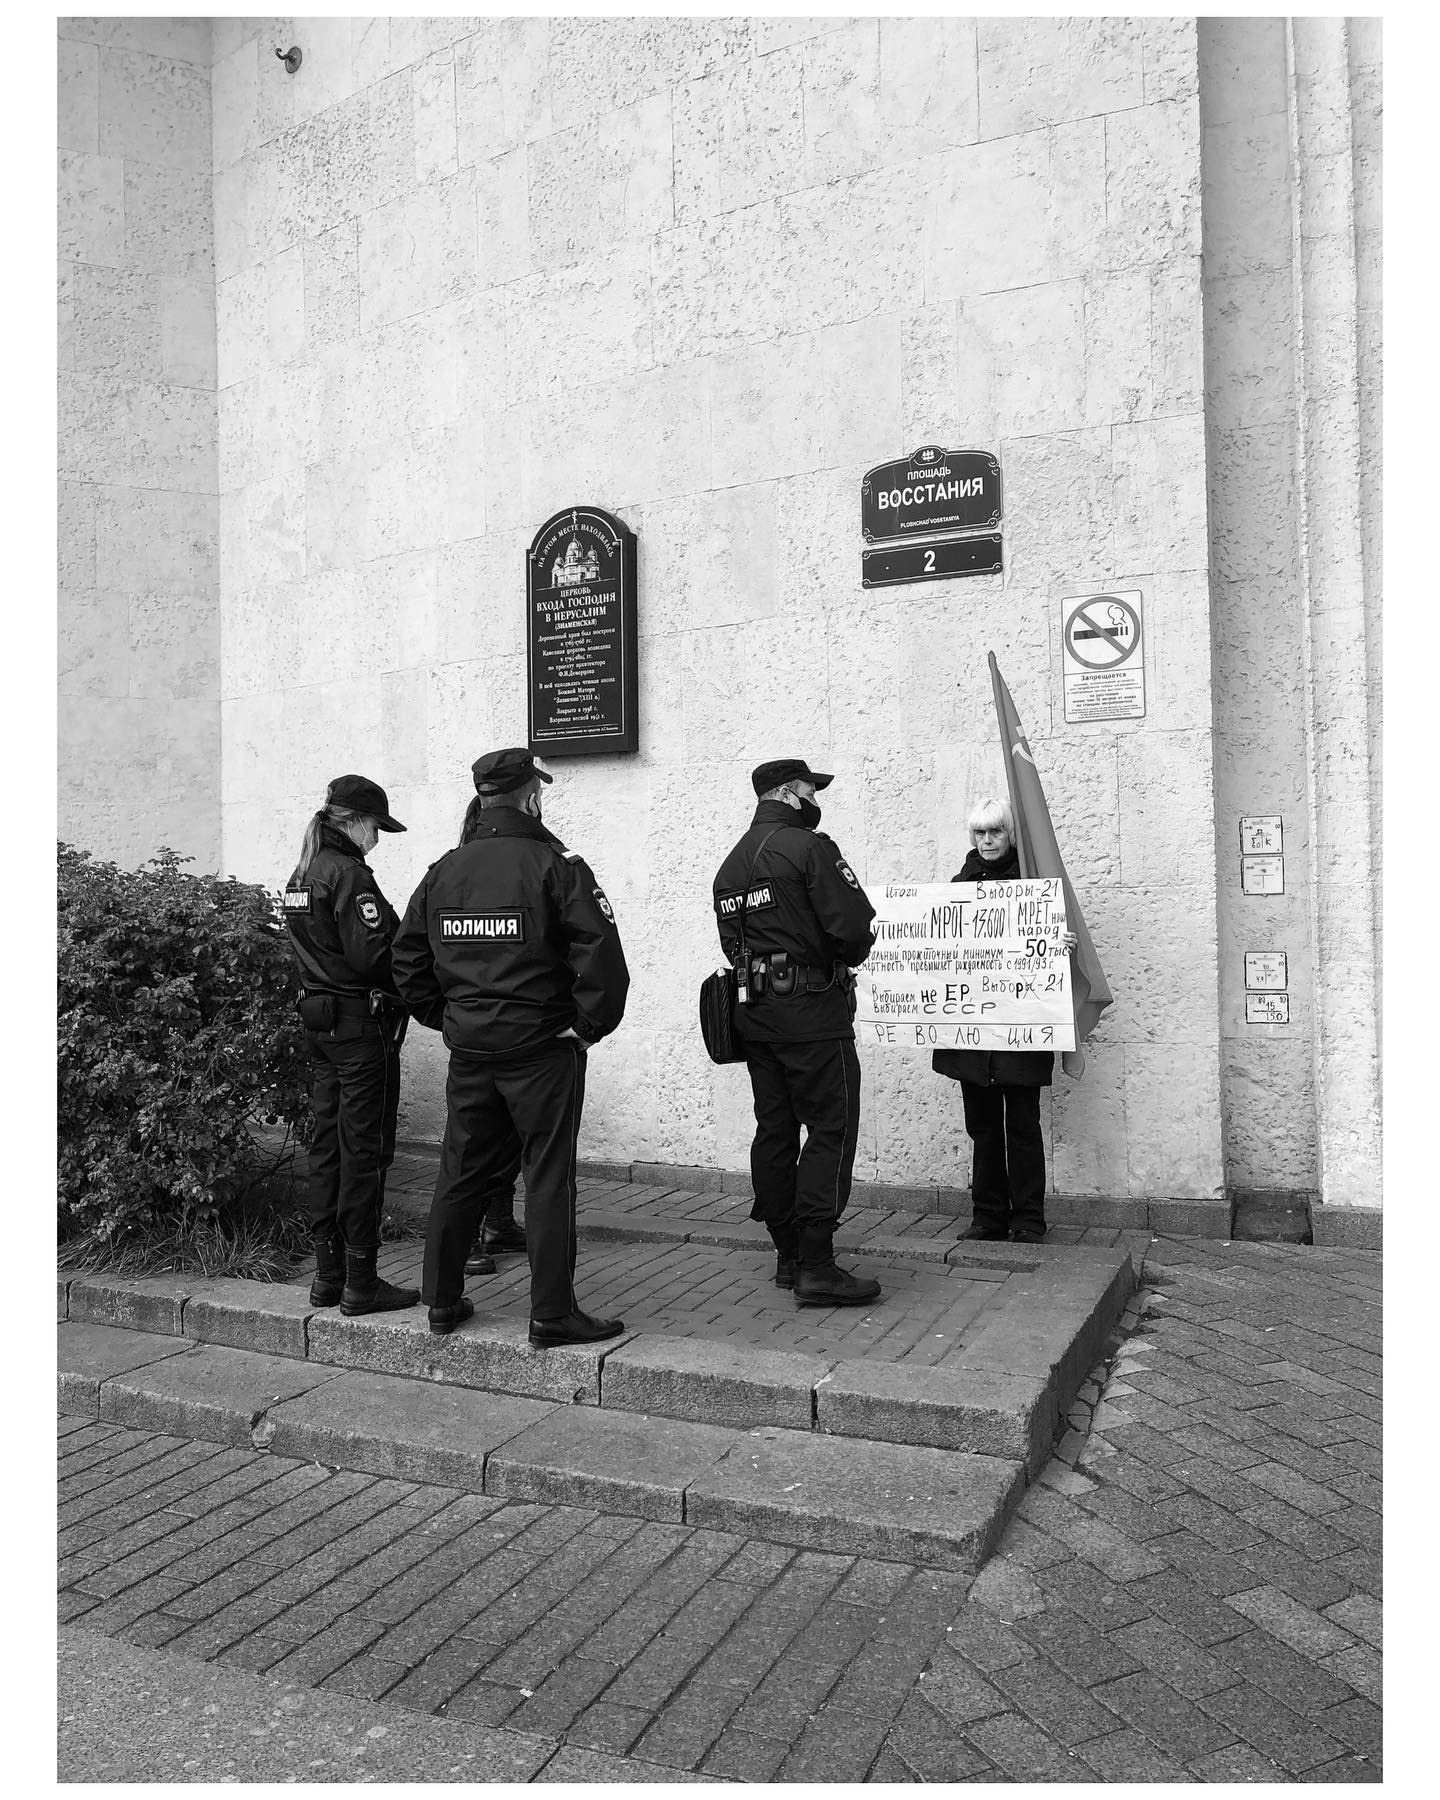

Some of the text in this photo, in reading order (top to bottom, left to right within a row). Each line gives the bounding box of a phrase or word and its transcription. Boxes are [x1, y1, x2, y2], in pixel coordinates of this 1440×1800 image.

[907, 466, 952, 481] ПЛОЩАДЬ
[878, 477, 984, 510] ВОССТАНИЯ
[538, 524, 614, 568] НА ЭТОМ МЕСТЕ НАХОДИЛАСЬ
[923, 550, 936, 572] 2
[536, 592, 616, 612] ВХОДА ГОСПОДНЯ
[560, 586, 591, 598] ЦЕРКОВЬ
[546, 606, 607, 622] В ИЕРУСАЛИМ
[555, 618, 598, 631] (ЗНАМЕНСКАЯ)
[1081, 673, 1126, 681] Запрещается
[886, 886, 918, 898] Итоги
[1018, 898, 1054, 926] МРЁТ
[443, 918, 518, 938] ПОЛИЦИЯ
[872, 913, 928, 940] утинский
[1018, 926, 1060, 940] народ
[868, 944, 900, 961] альный
[963, 949, 1004, 960] минимум
[1025, 938, 1047, 958] 50
[872, 984, 916, 1005] Выбираем
[921, 990, 938, 1004] не
[1265, 1002, 1275, 1010] 15
